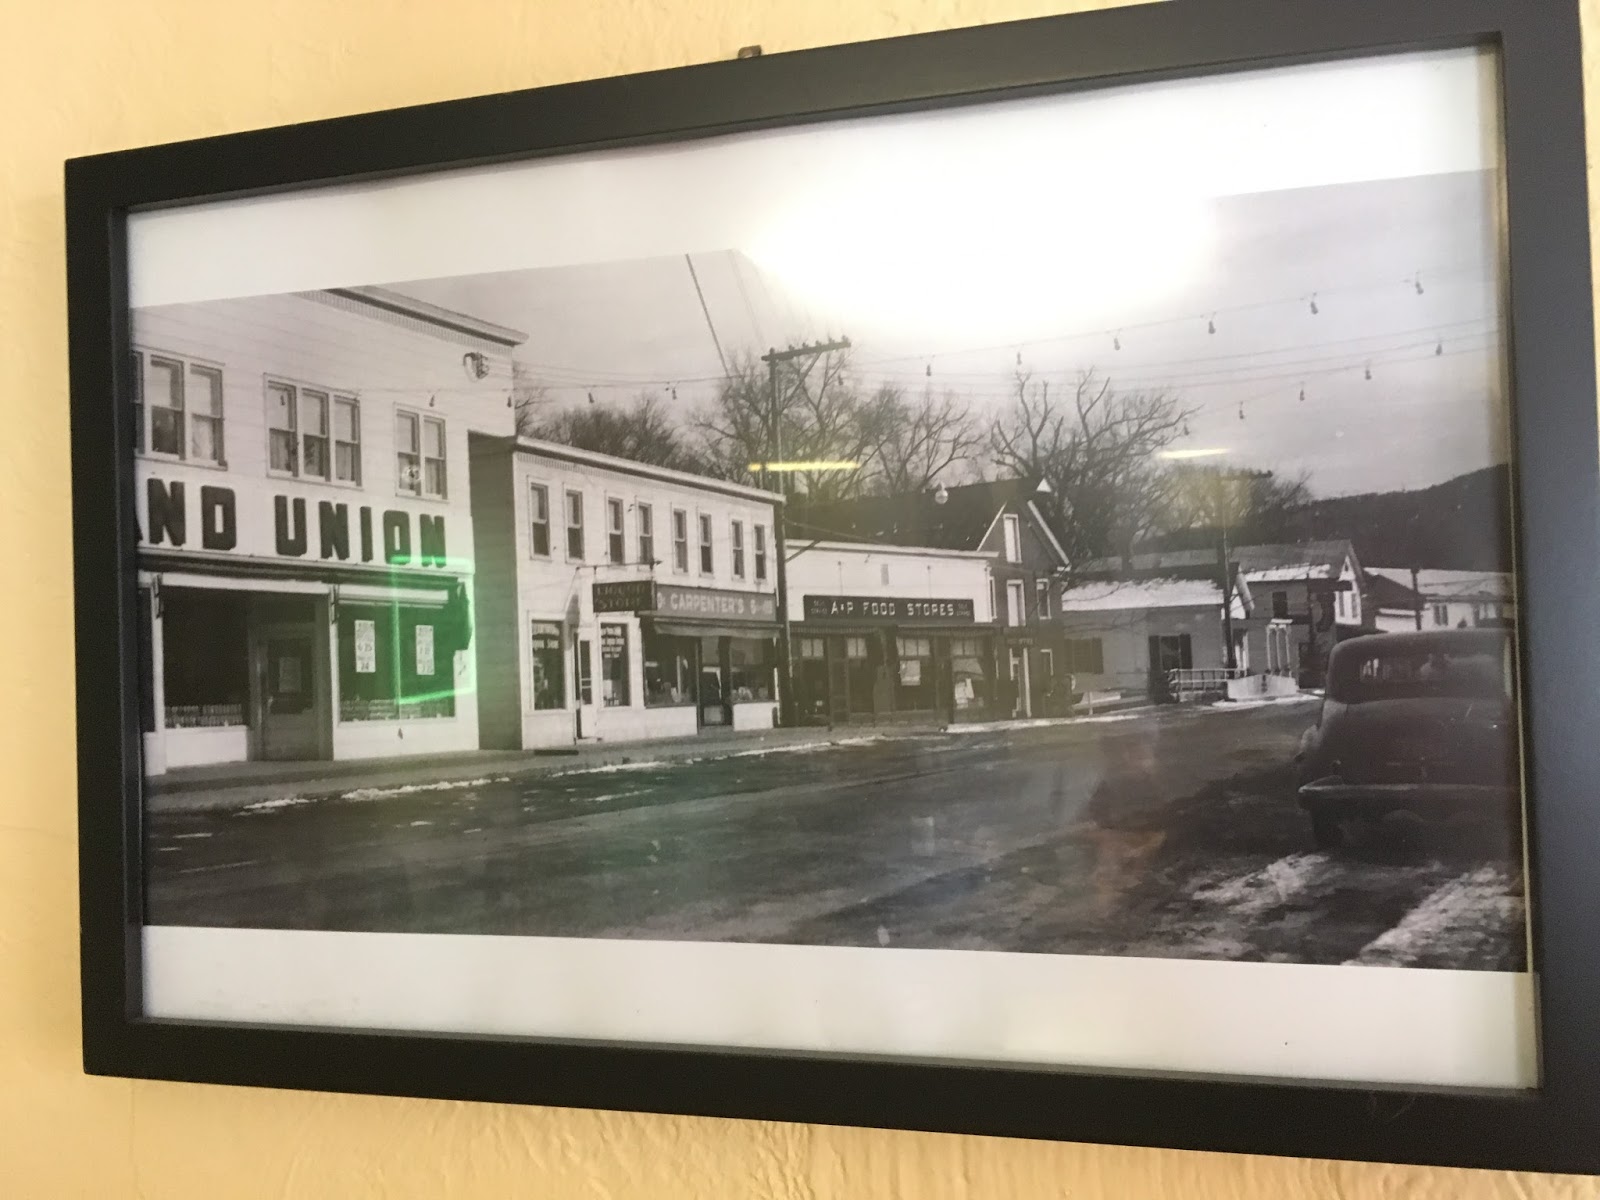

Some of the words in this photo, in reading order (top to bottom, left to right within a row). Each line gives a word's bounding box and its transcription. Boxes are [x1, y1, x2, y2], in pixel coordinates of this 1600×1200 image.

[137, 478, 237, 551] ND
[274, 494, 447, 568] UNION
[862, 602, 896, 616] FOOD
[906, 603, 955, 616] STORES
